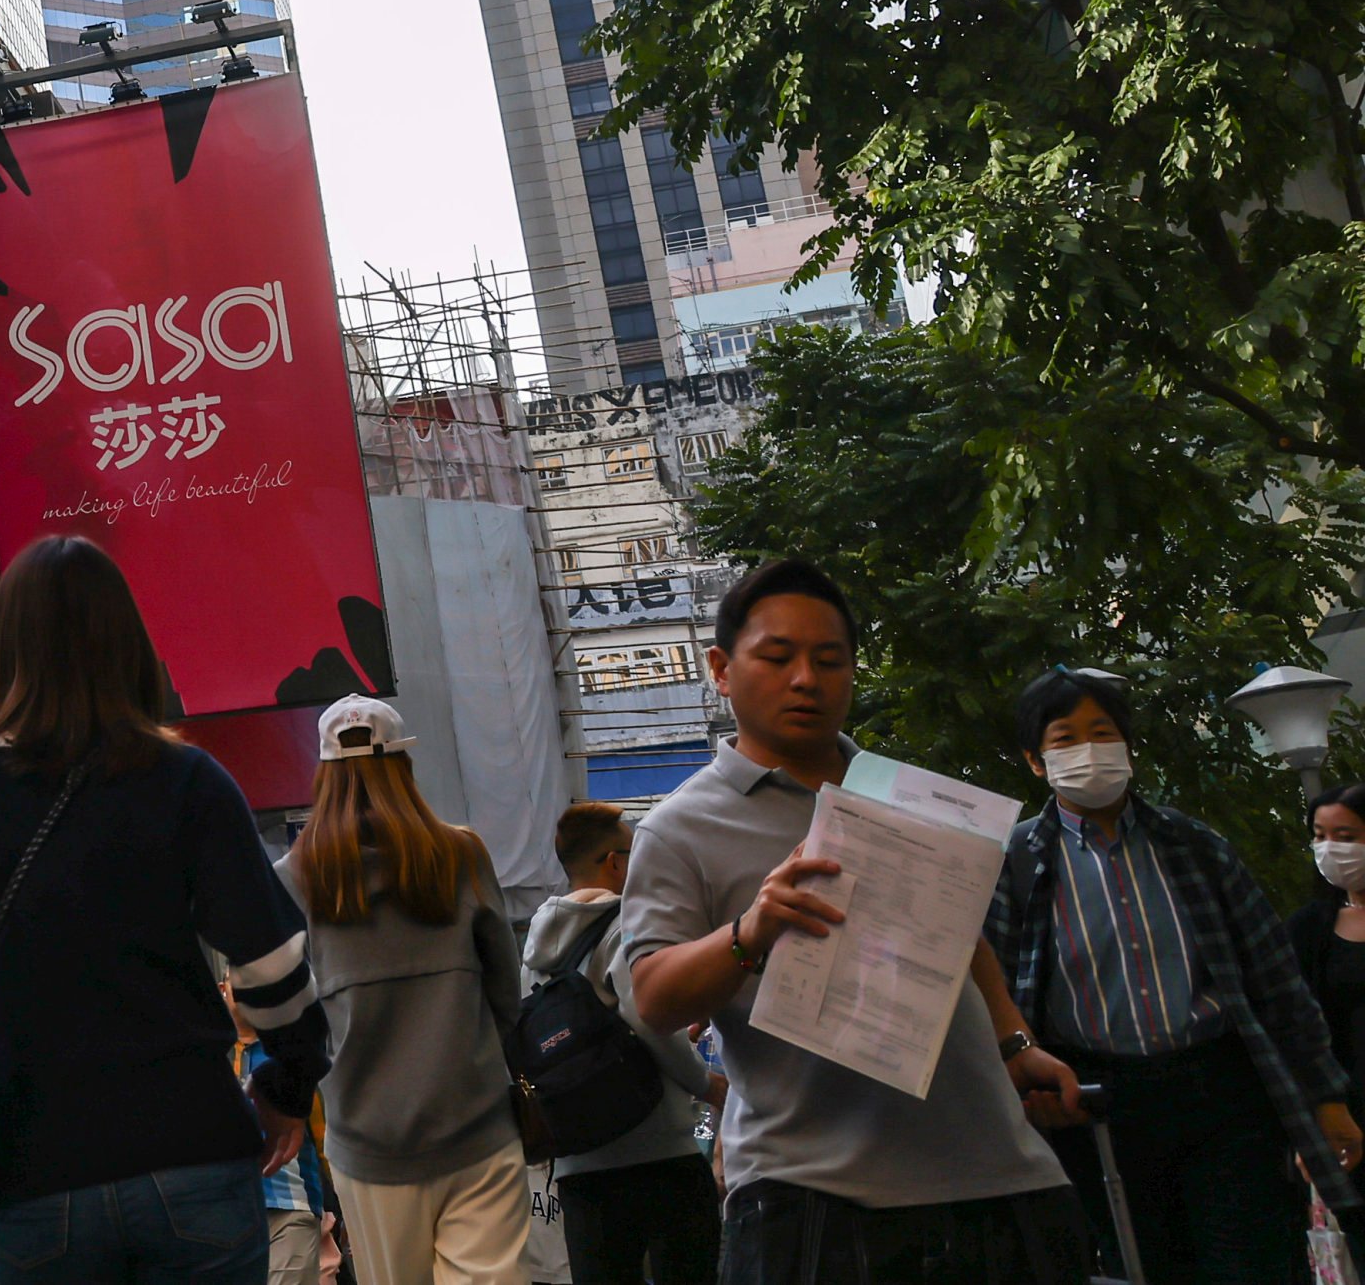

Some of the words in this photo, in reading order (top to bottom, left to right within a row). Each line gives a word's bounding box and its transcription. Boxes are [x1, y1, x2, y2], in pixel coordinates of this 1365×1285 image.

[90, 393, 226, 470] 莎莎
[43, 491, 126, 525] making
[133, 478, 180, 518] life
[186, 461, 292, 504] beautiful
